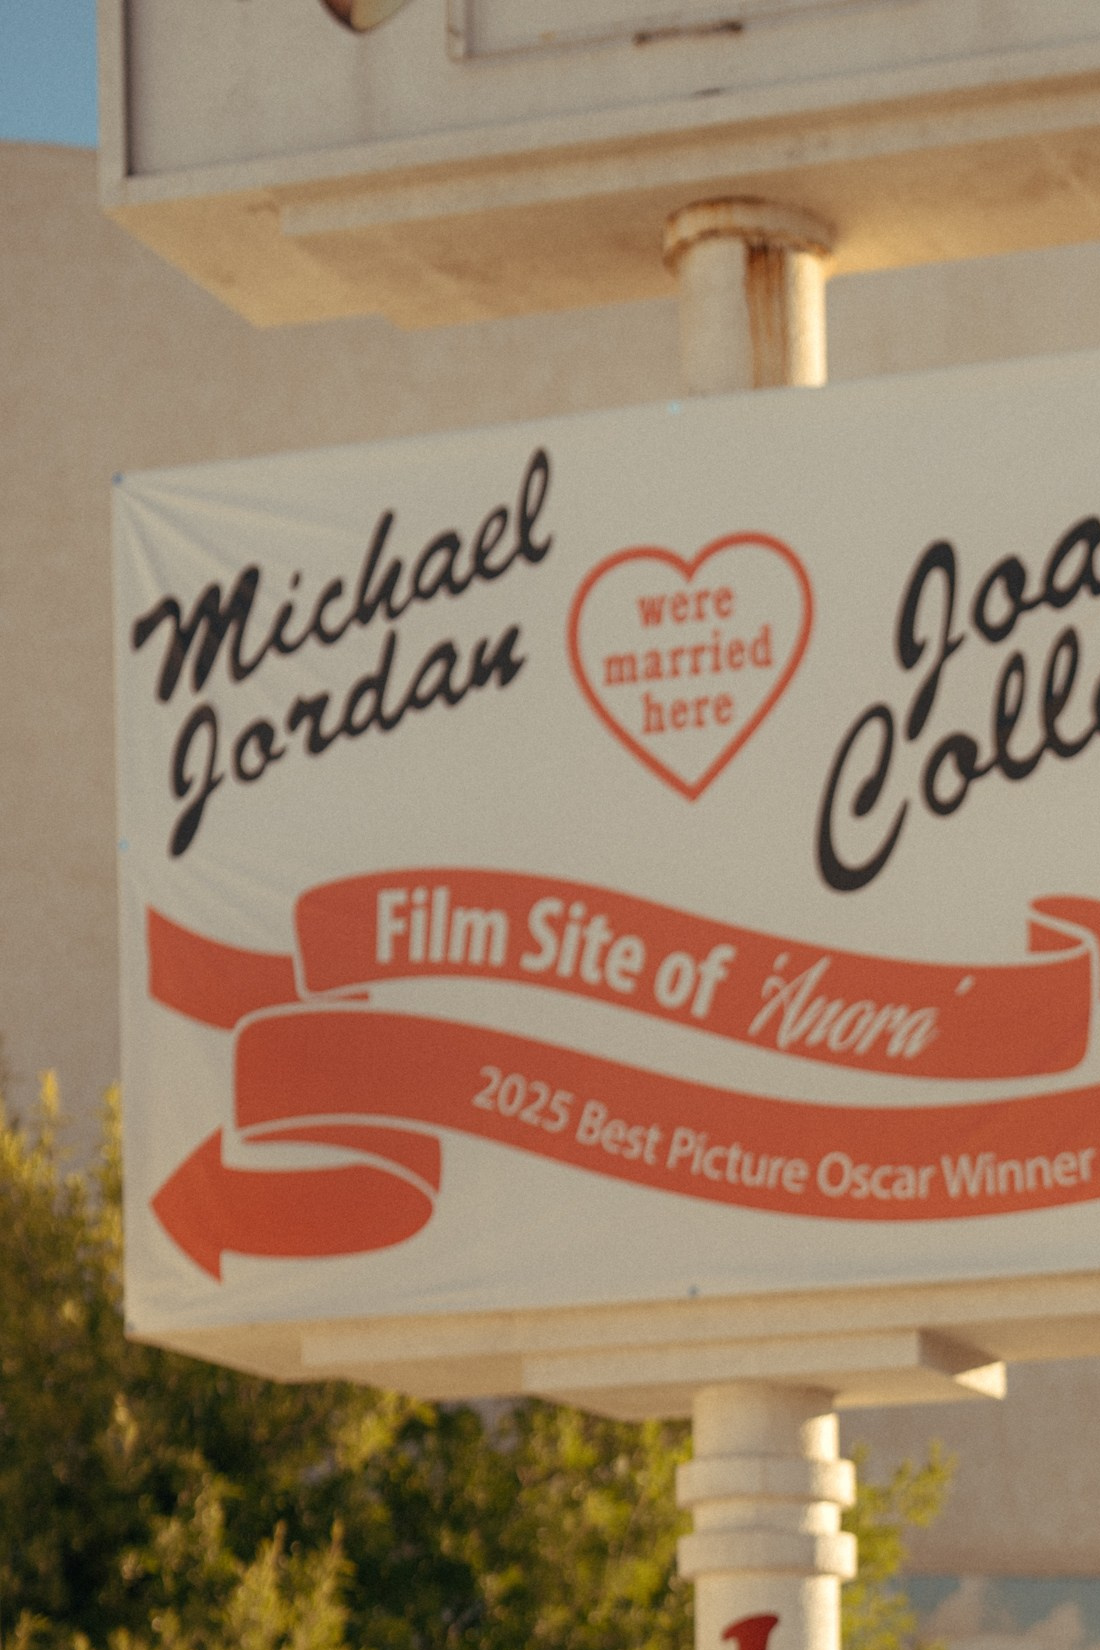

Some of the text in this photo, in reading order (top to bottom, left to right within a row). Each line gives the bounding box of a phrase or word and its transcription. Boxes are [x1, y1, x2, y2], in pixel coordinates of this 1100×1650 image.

[131, 447, 553, 702] Michael
[636, 586, 736, 629] were
[604, 626, 775, 687] married
[642, 690, 735, 735] here
[169, 622, 527, 859] Jordan
[375, 887, 508, 967] Film
[520, 895, 648, 993] Site
[653, 943, 736, 1020] of
[471, 1065, 1096, 1200] 2025 Best Picture Oscar Winner
